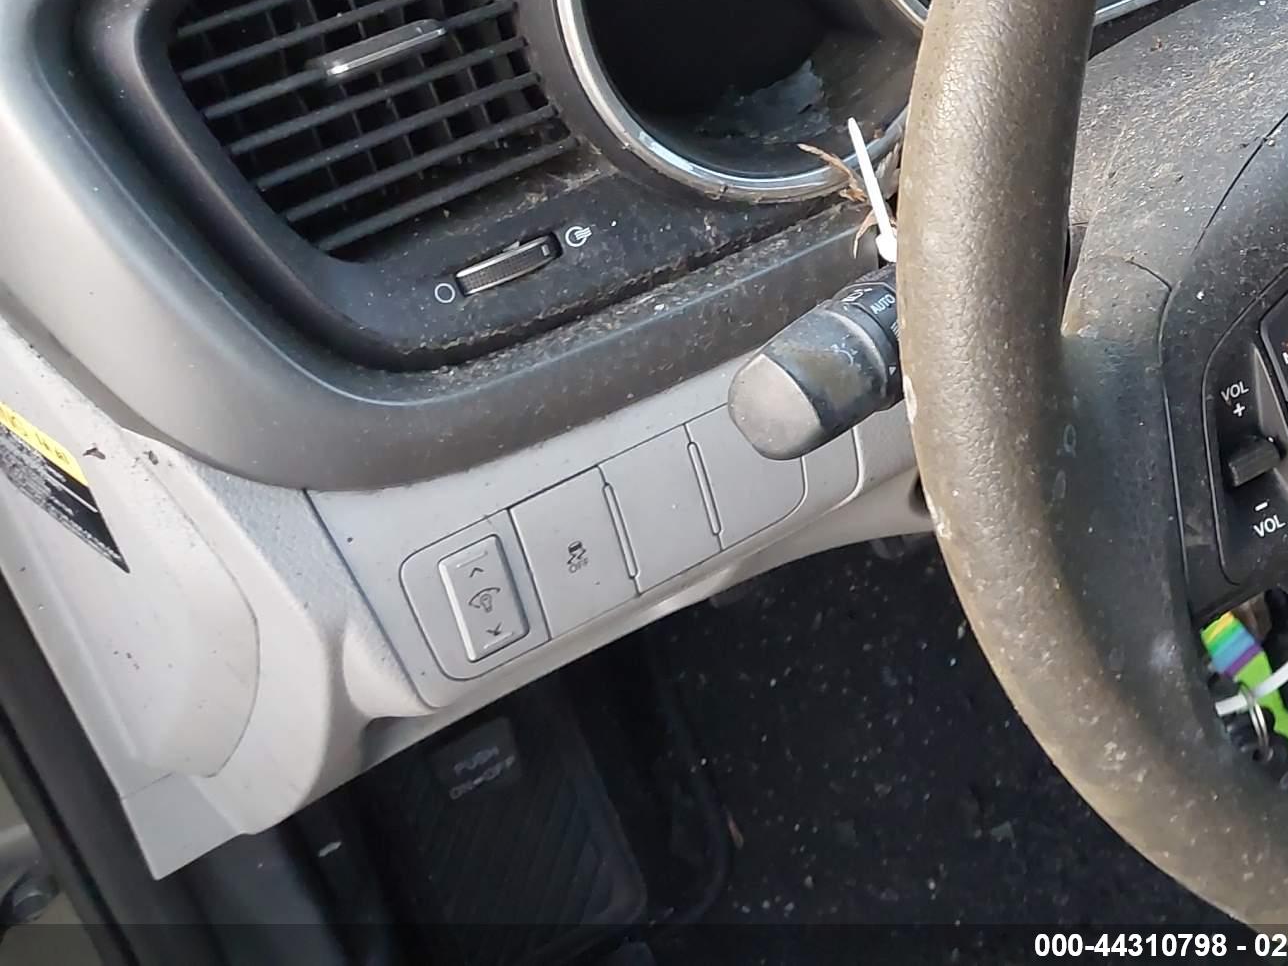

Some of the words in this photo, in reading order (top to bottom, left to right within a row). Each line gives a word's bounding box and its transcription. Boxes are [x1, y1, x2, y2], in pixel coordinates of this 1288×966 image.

[870, 294, 896, 315] AUTO
[1220, 380, 1249, 404] VOL
[1253, 514, 1287, 538] VOL
